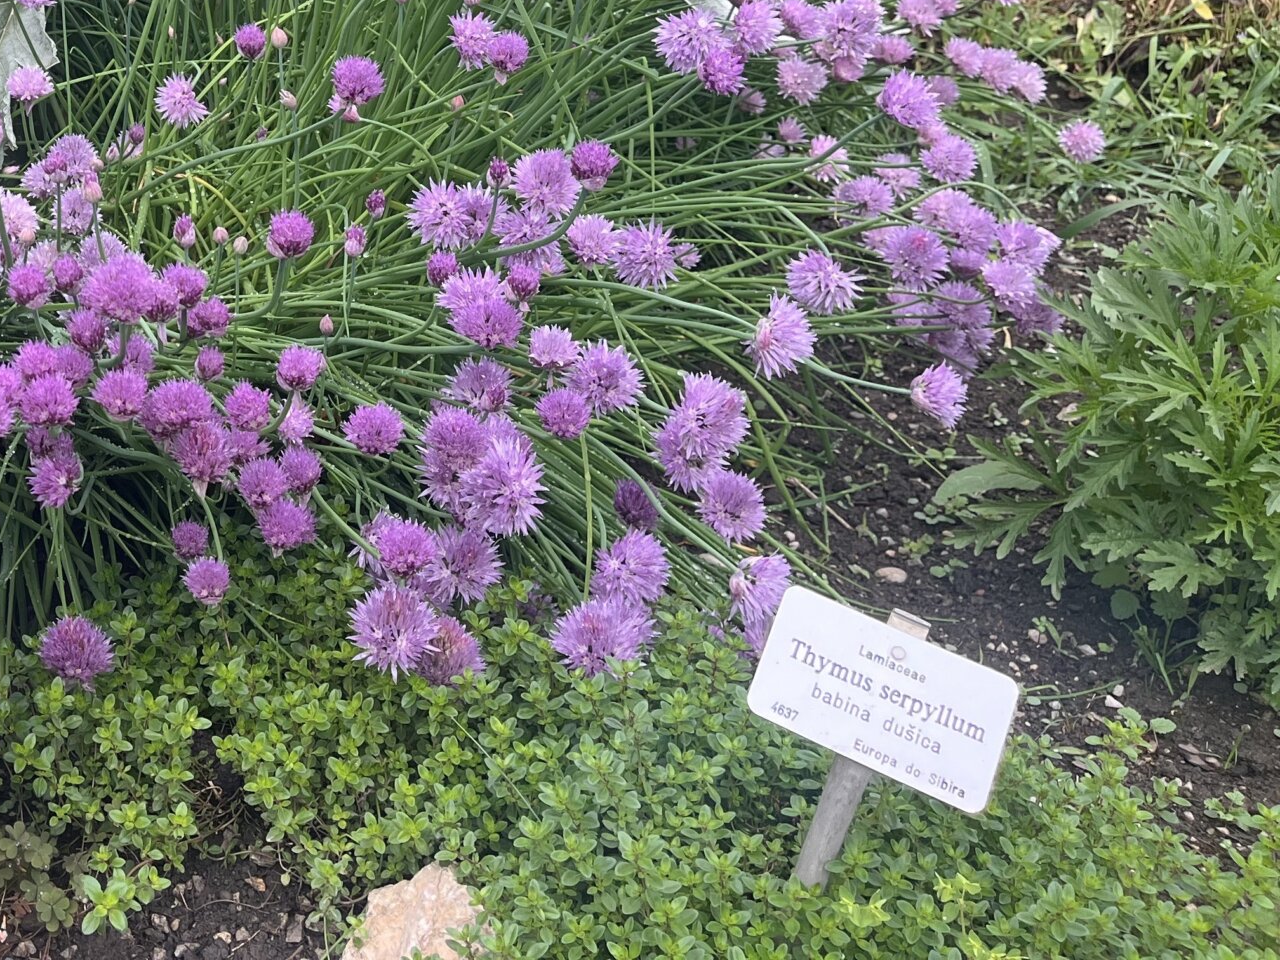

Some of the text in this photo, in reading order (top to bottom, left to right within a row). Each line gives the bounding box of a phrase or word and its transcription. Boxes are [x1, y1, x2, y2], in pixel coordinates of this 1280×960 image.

[789, 638, 986, 743] Thymus serpyllum
[858, 645, 927, 684] Lamiaceae
[770, 700, 799, 722] 4637
[811, 682, 942, 755] babina dušica
[852, 738, 966, 799] Europa do Sibira
